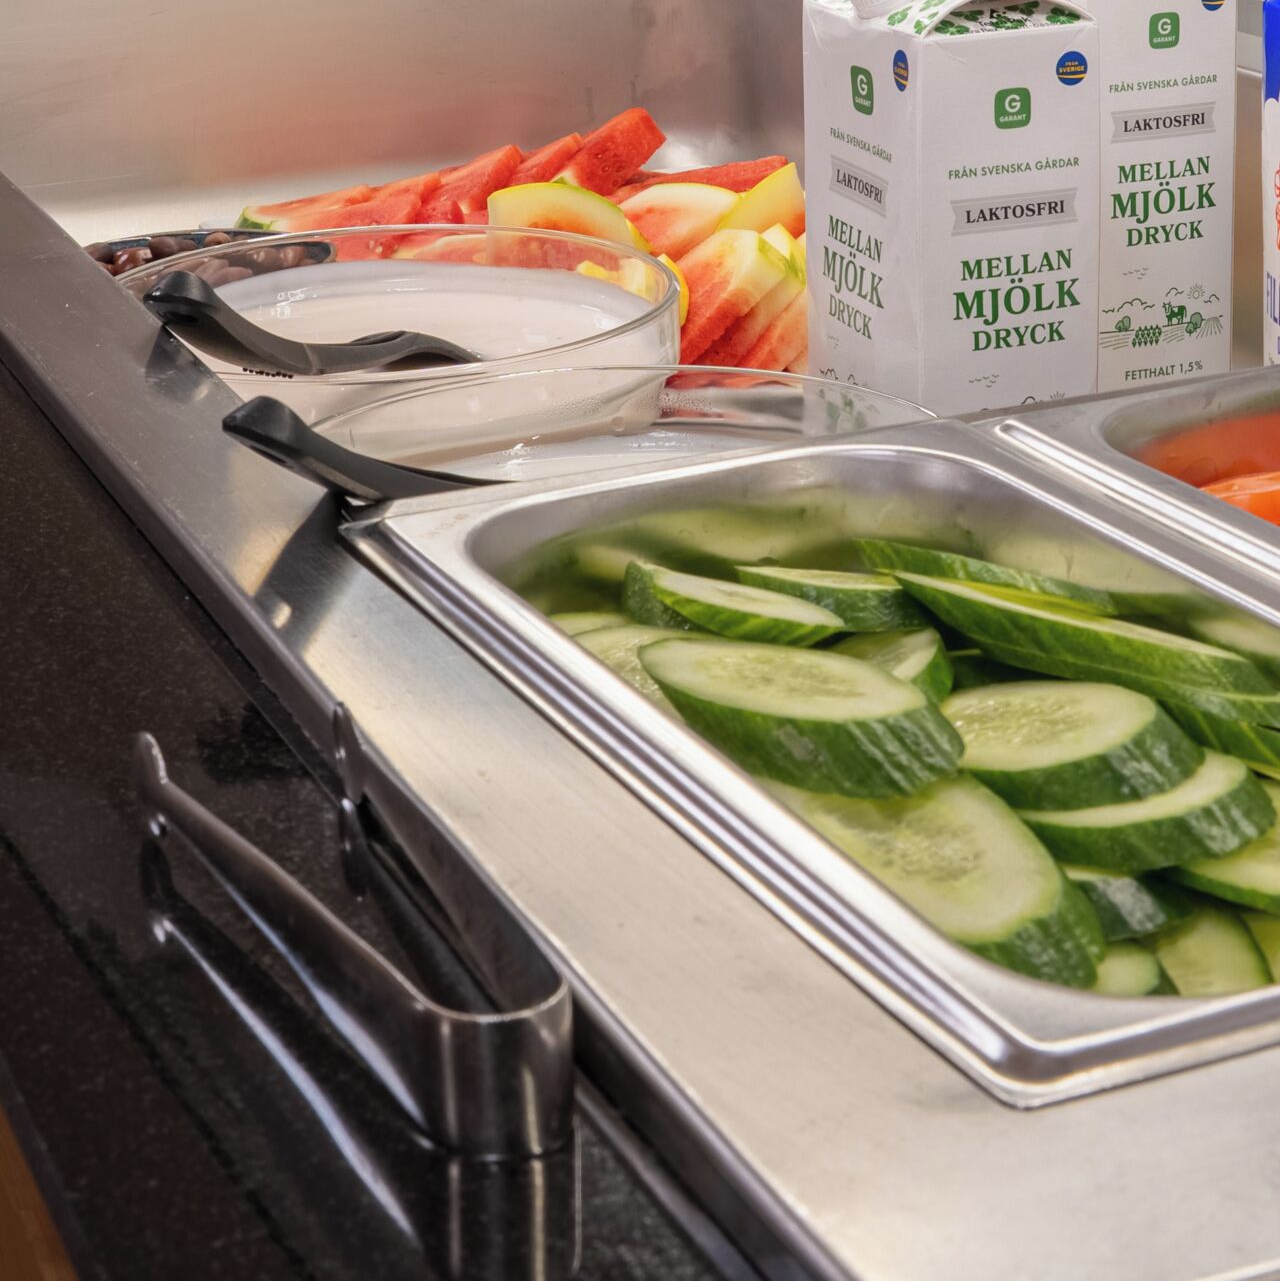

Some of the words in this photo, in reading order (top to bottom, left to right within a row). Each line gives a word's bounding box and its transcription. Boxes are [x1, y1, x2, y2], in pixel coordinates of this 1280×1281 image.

[1157, 18, 1172, 35] G
[1152, 35, 1176, 44] GARANT
[1059, 65, 1085, 73] SVERIGE
[856, 74, 868, 96] G
[1109, 82, 1134, 94] FRÅN
[1137, 78, 1179, 91] SVENSKA
[1181, 74, 1218, 86] GÅRDAR
[854, 95, 872, 108] GARANT
[1004, 94, 1021, 113] G
[999, 114, 1027, 123] GARANT
[1123, 112, 1206, 133] LAKTOSFRI
[830, 127, 846, 142] FRÅN
[846, 134, 871, 153] SVENSKA
[948, 166, 977, 180] FRÅN
[981, 162, 1032, 177] SVENSKA
[1035, 157, 1080, 171] GÅRDAR
[1117, 155, 1210, 184] MELLAN
[836, 169, 883, 204] LAKTOSFRI
[965, 200, 1065, 224] LAKTOSFRI
[1110, 181, 1217, 224] MJÖLK
[827, 214, 883, 264] MELLAN
[1125, 220, 1204, 247] DRYCK
[960, 248, 1073, 281] MELLAN
[822, 245, 885, 309] MJÖLK
[953, 277, 1081, 326] MJÖLK
[828, 293, 873, 341] DRYCK
[972, 320, 1066, 352] DRYCK
[1124, 365, 1176, 381] FETTHALT
[1179, 359, 1204, 376] 1,5%
